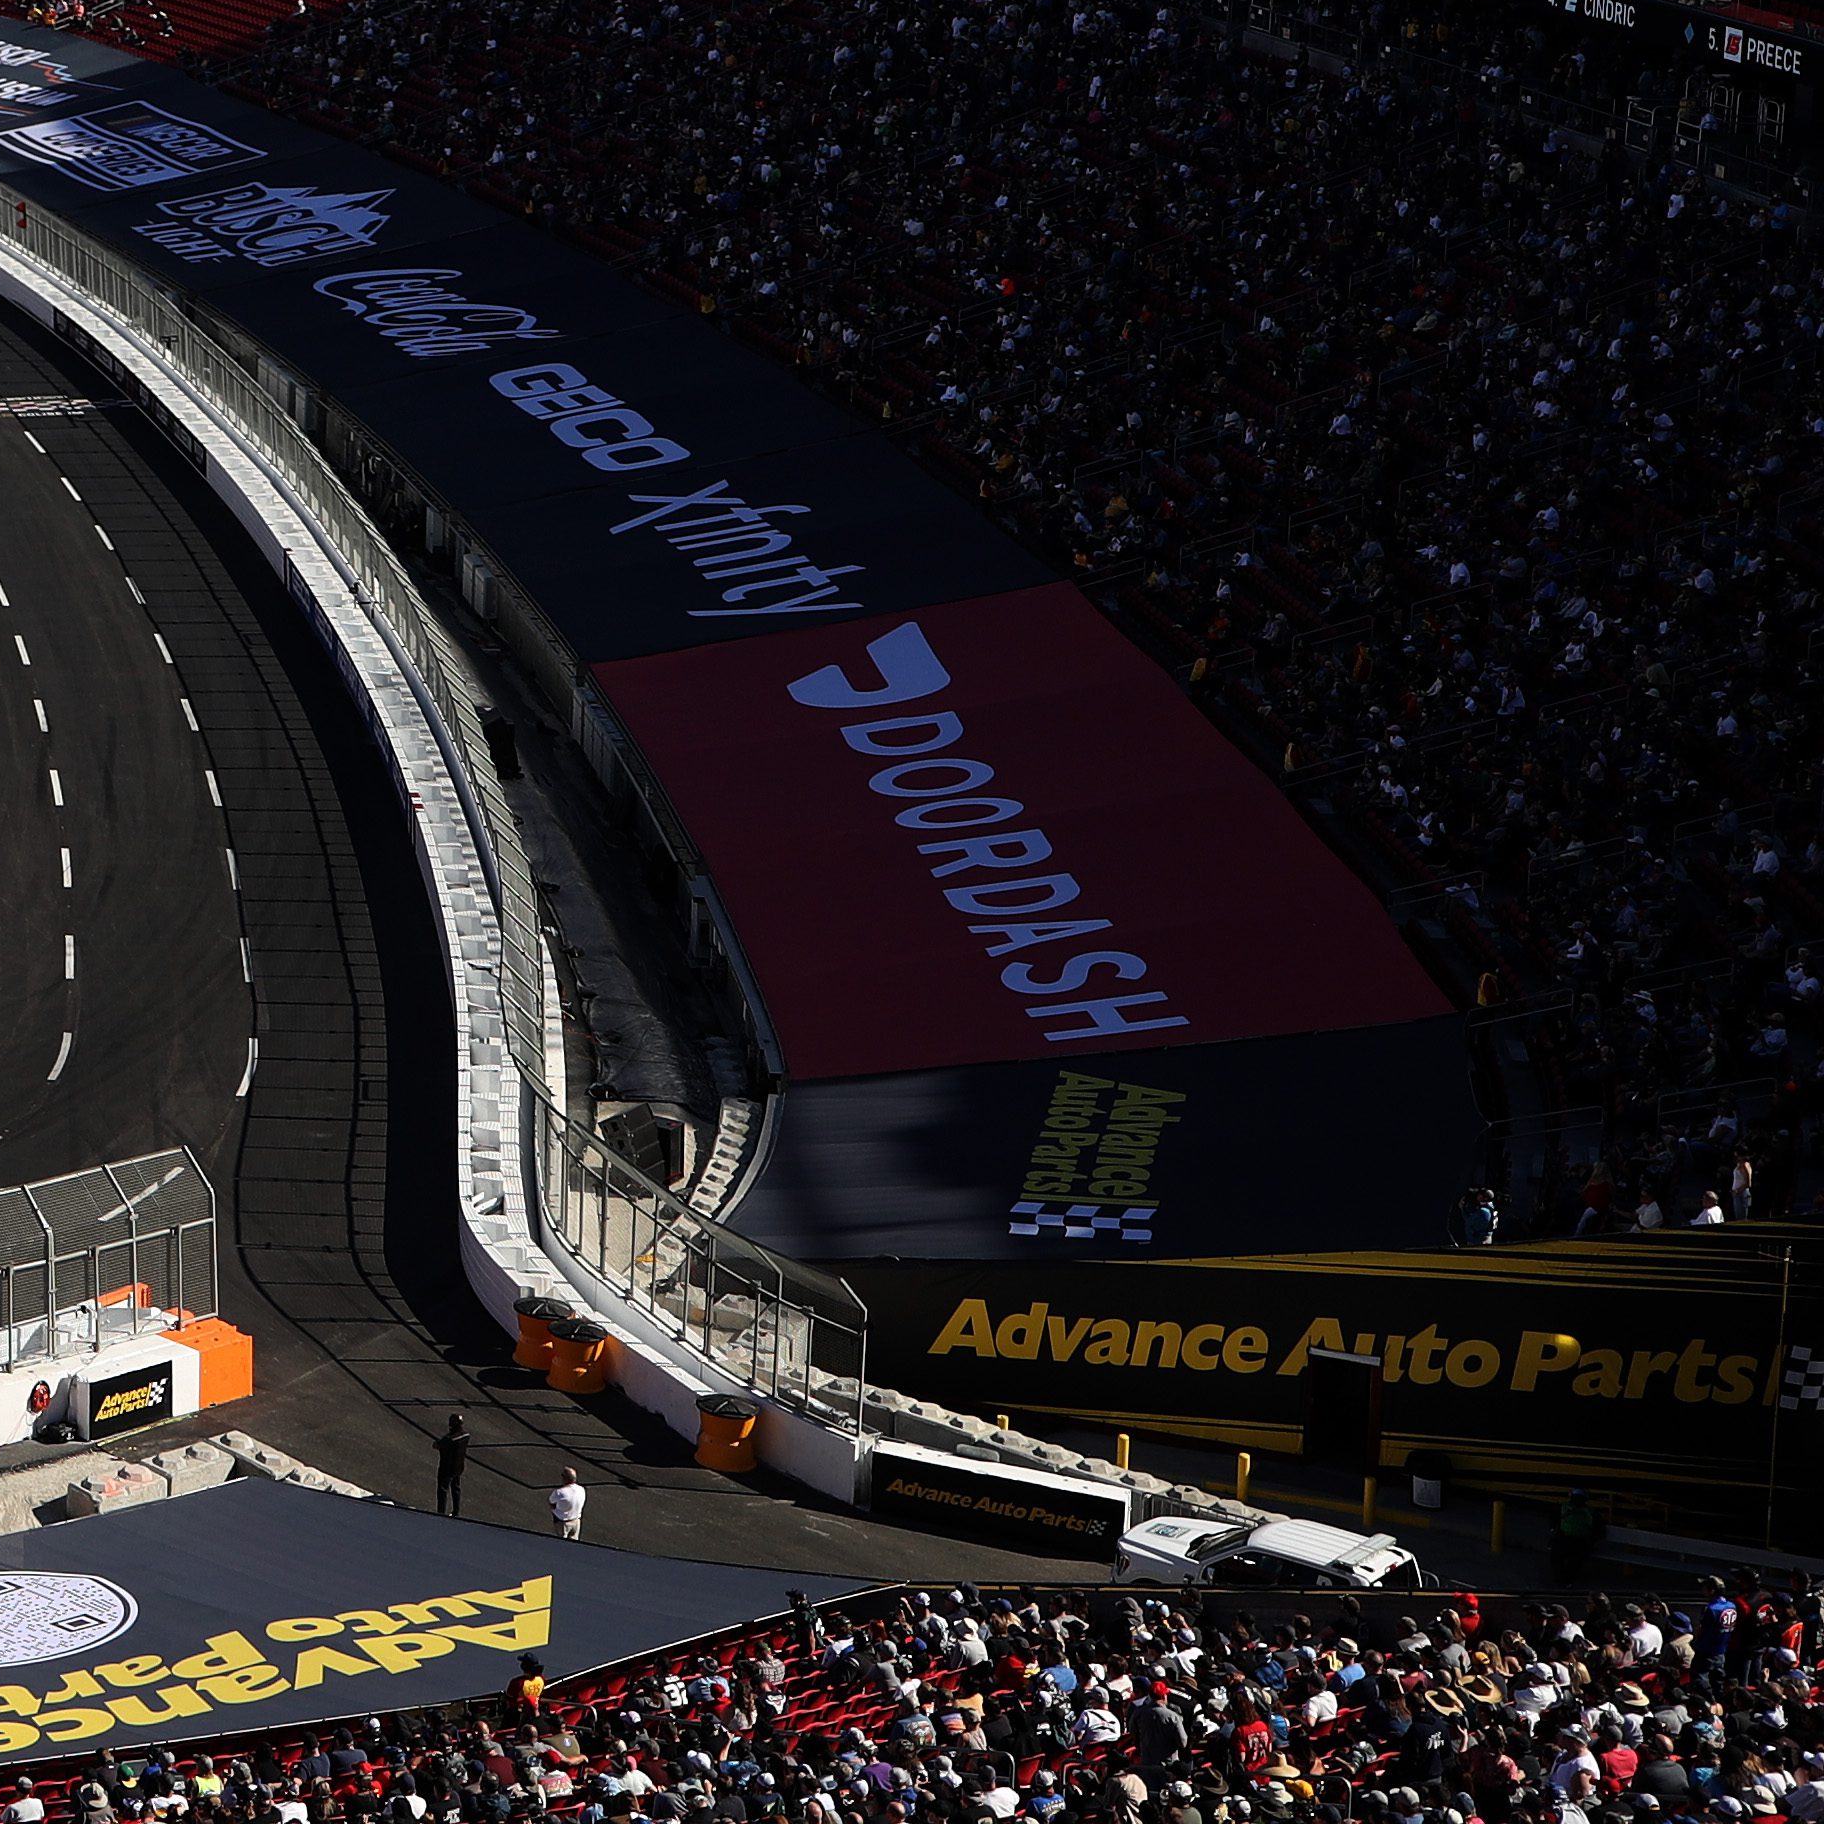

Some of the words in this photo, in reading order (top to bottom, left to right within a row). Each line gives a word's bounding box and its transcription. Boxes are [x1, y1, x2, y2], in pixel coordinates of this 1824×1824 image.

[1747, 38, 1802, 75] PREECE
[138, 121, 232, 162] NASCAR
[132, 221, 241, 264] LIGHT
[160, 182, 376, 266] BUSCH
[313, 269, 562, 358] Coca-Cola
[490, 363, 690, 472] GEICO
[610, 480, 865, 617] xfinity
[840, 711, 1190, 1042] DOORDASH
[1045, 1070, 1114, 1134] Auto
[1021, 1131, 1101, 1194] Parts
[1087, 1081, 1187, 1199] Advance
[928, 1298, 1269, 1374] Advance
[1510, 1331, 1758, 1405] Parts
[95, 1404, 119, 1422] Auto
[120, 1398, 147, 1415] Parts
[101, 1386, 148, 1411] Advance
[886, 1478, 973, 1508] Advance
[973, 1496, 1027, 1519] Auto
[1028, 1507, 1086, 1532] Parts
[267, 1575, 552, 1644] Auto
